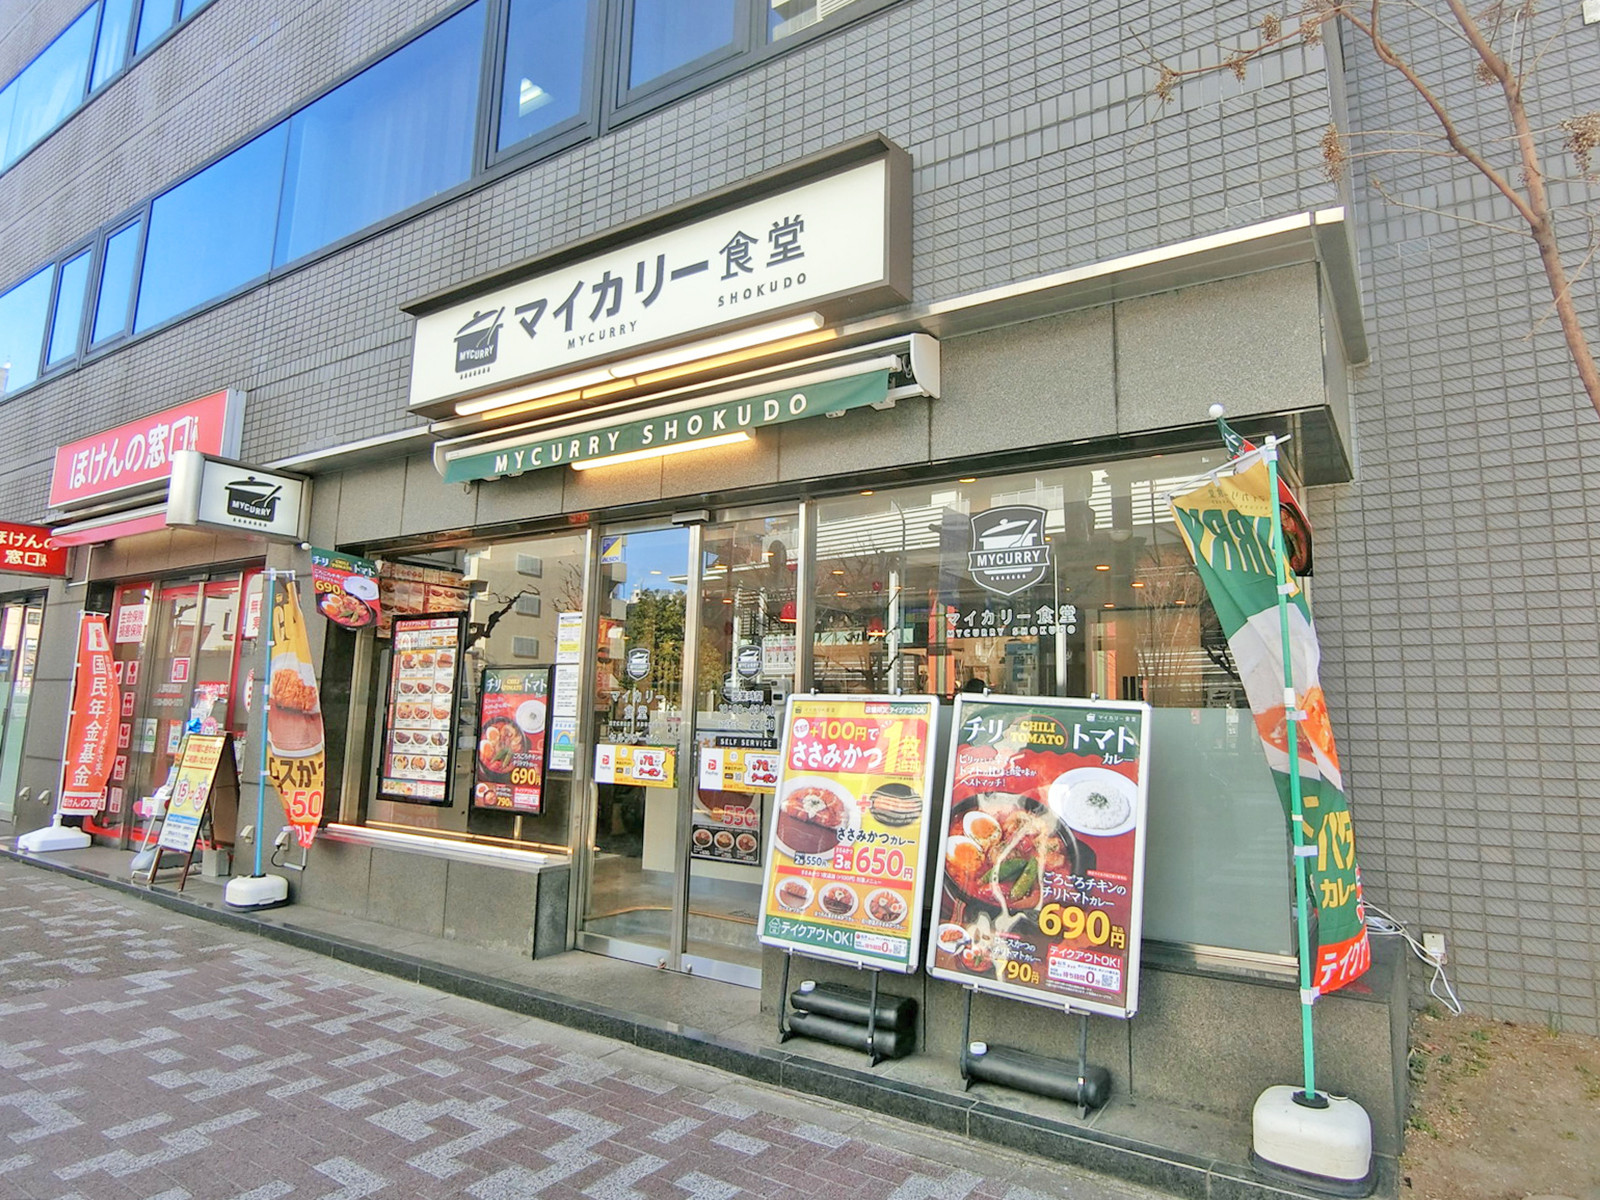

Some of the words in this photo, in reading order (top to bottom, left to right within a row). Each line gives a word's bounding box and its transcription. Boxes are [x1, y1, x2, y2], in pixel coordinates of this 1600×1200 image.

[513, 213, 806, 340] マイカリー食堂
[567, 320, 638, 350] MYCURRY
[717, 272, 808, 308] SHOKUDO
[459, 344, 495, 362] MYCURRY
[494, 430, 622, 474] MYCURRY
[643, 392, 808, 446] SHOKUDO
[69, 415, 191, 490] ほけんの窓口
[231, 500, 272, 516] MYCURRY
[977, 550, 1041, 567] MYCURRY
[946, 604, 1077, 627] マイカリー食堂
[947, 628, 1005, 638] MYCURRY
[72, 654, 107, 787] 国民年金基金
[1020, 719, 1056, 734] CHILI
[720, 737, 738, 747] SELF
[741, 738, 773, 748] SERVICE
[963, 715, 1005, 744] チリ
[1072, 723, 1136, 754] トマト
[1010, 731, 1065, 746] TOMATO
[791, 741, 883, 769] ささみかつ
[1102, 752, 1135, 766] カレー
[837, 827, 915, 846] ささみかつカレー
[856, 847, 914, 880] 650円
[1042, 871, 1127, 896] ごろごろチキンの
[1041, 885, 1116, 908] チリトマトカレー
